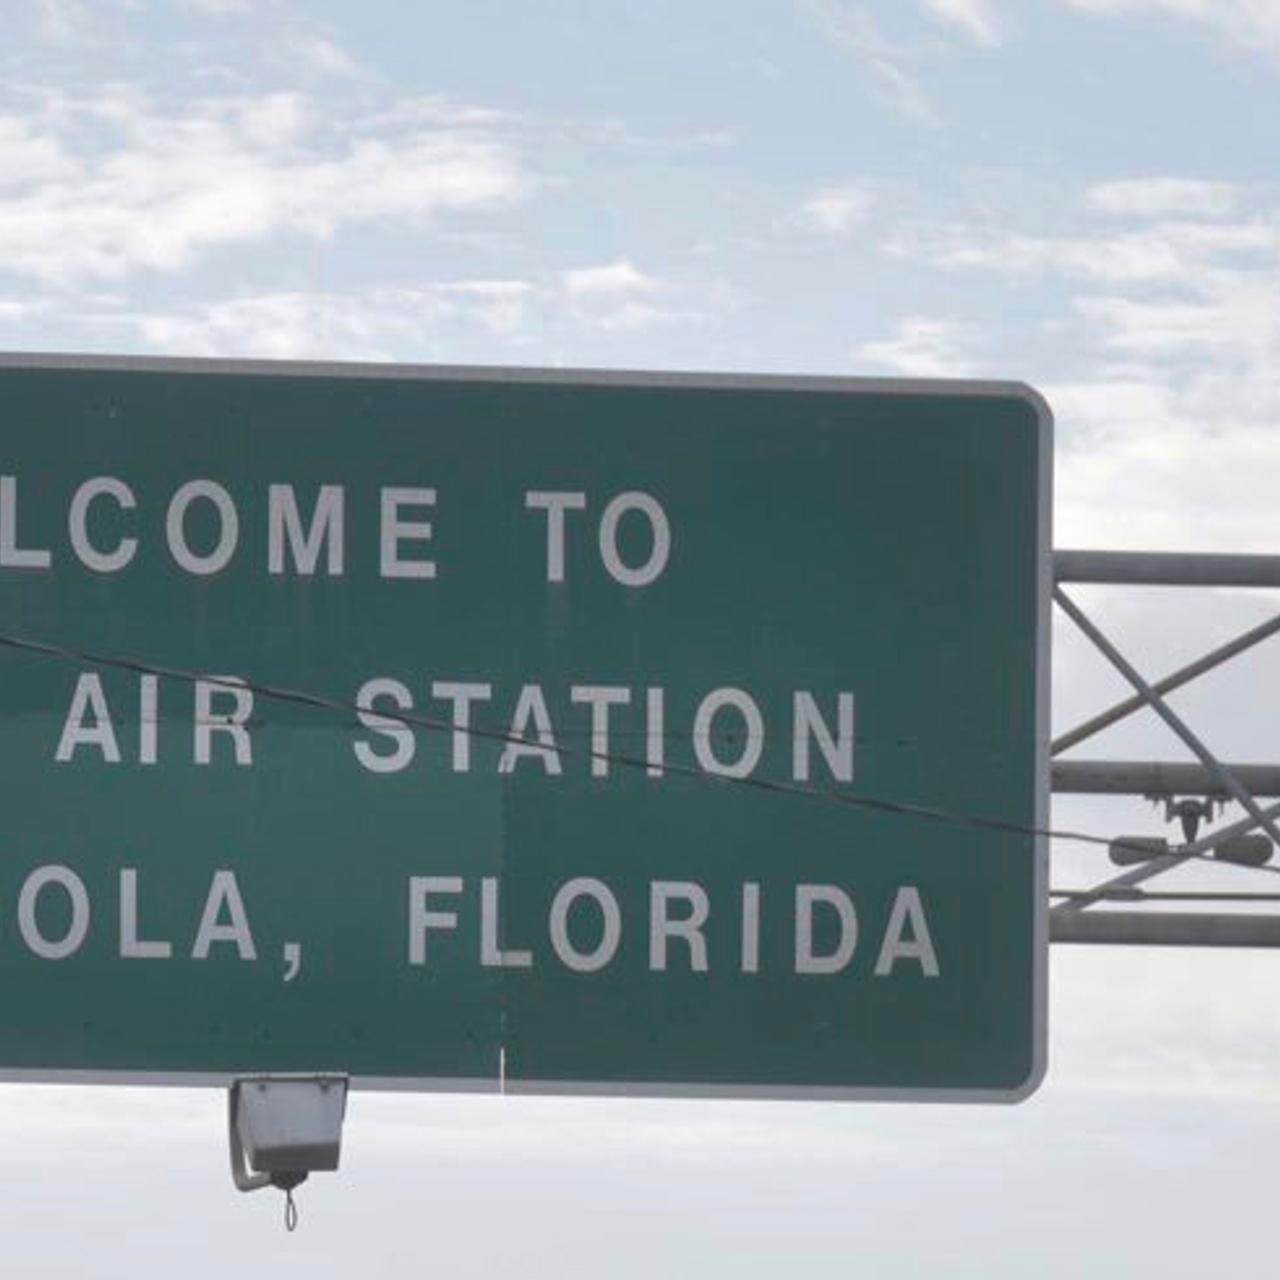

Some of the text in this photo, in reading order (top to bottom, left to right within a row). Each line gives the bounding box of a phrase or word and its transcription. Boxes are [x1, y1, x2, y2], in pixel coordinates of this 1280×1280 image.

[0, 475, 672, 587] LCOME TO
[54, 672, 856, 782] AIR STATION
[17, 864, 941, 982] OLA, FLORIDA
